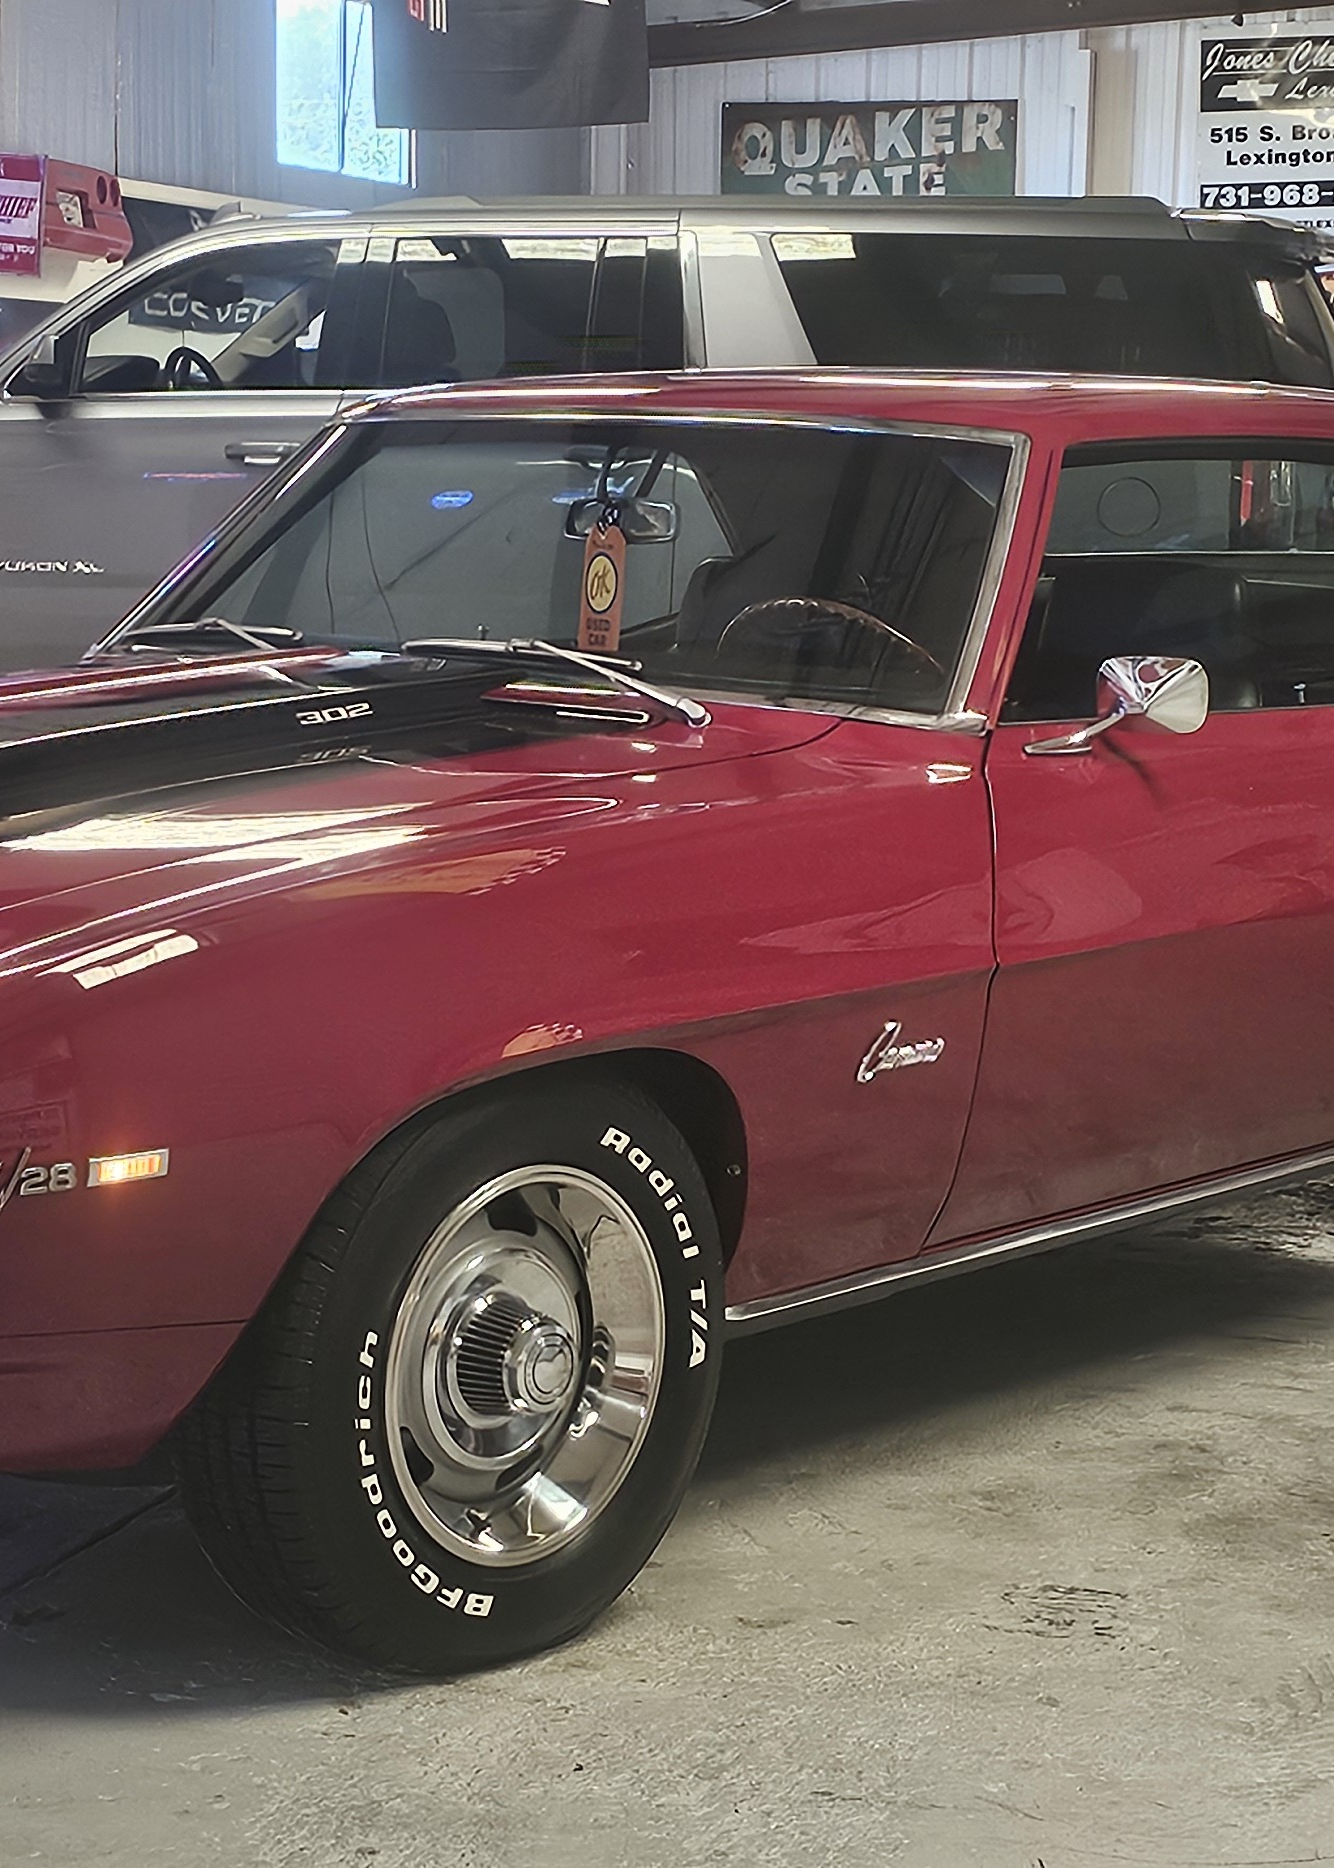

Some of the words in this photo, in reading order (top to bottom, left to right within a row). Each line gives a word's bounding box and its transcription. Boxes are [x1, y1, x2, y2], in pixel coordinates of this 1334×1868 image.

[1202, 43, 1274, 80] Jones
[732, 102, 1005, 175] QUAKER
[1210, 126, 1248, 143] 515
[1259, 125, 1281, 142] S.
[784, 164, 946, 196] STATE
[72, 561, 104, 574] XL
[590, 563, 611, 600] OK
[586, 617, 612, 633] USED
[587, 632, 608, 647] CAR
[295, 702, 374, 725] 302
[600, 1126, 701, 1259] Radial
[687, 1278, 709, 1368] T/A
[354, 1330, 495, 1617] BFGoodrich
